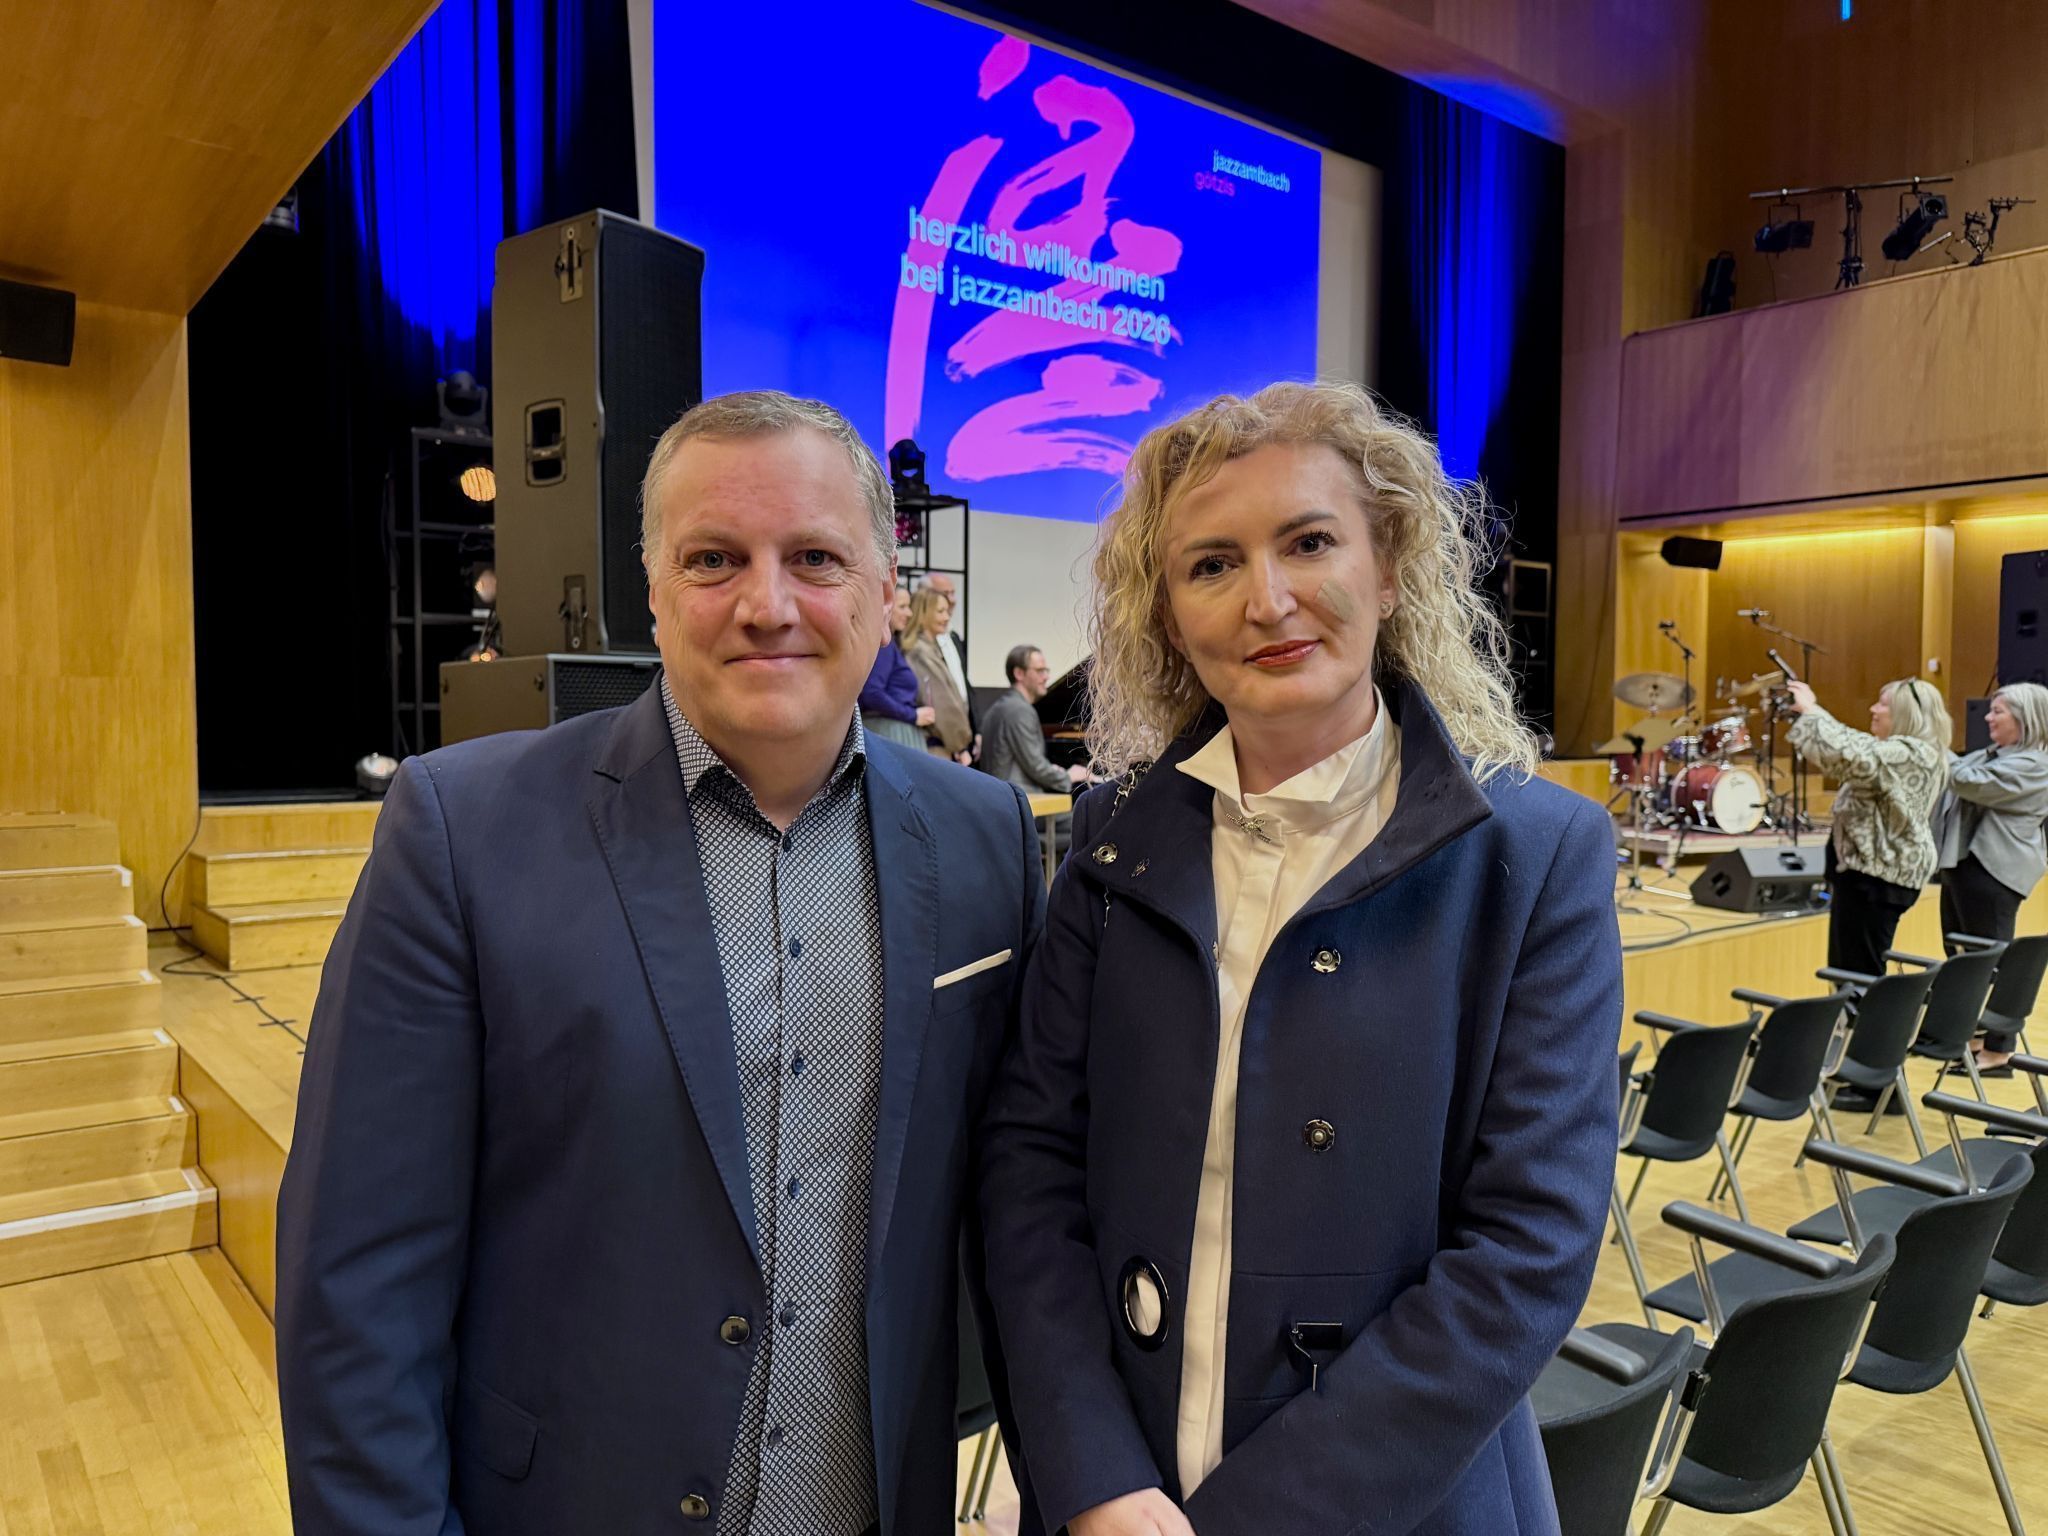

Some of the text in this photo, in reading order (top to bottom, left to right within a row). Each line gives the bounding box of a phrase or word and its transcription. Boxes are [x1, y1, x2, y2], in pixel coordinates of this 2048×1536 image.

[1213, 149, 1290, 193] jazzambach
[901, 252, 1171, 345] bei jazzambach 2026
[909, 205, 1165, 301] herzlich willkommen
